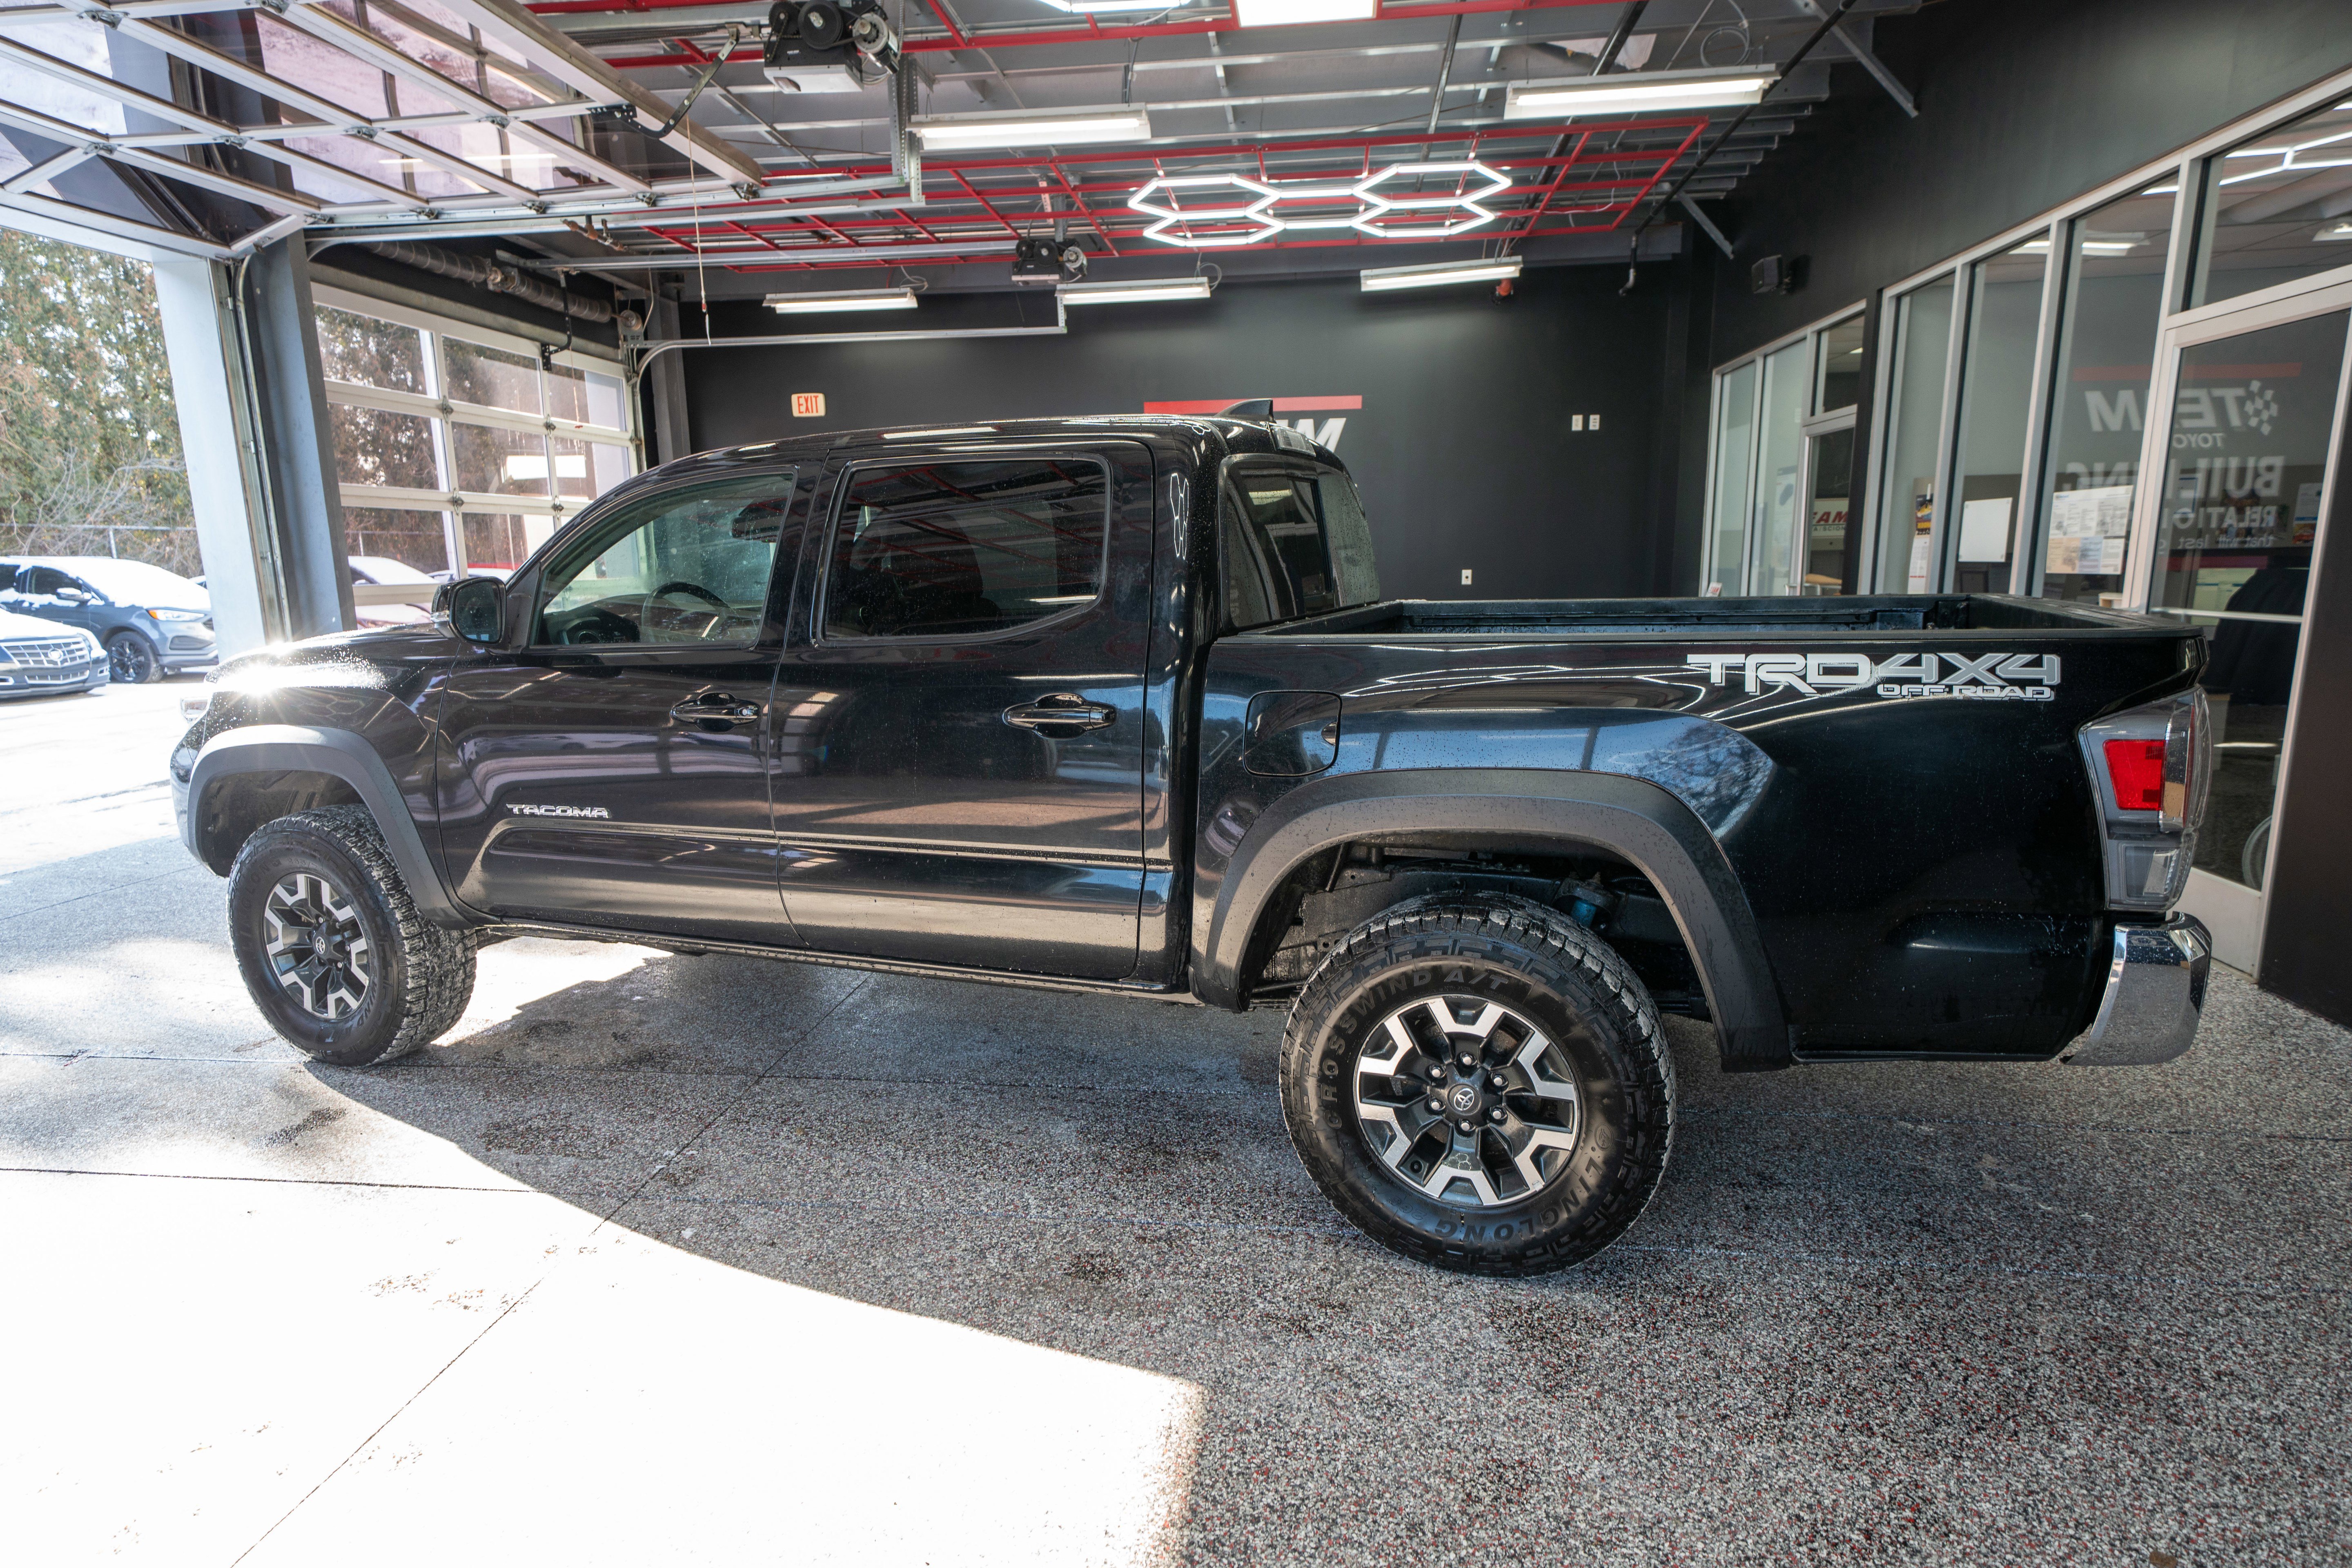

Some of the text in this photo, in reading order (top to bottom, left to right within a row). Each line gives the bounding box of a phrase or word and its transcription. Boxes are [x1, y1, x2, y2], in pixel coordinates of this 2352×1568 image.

[797, 395, 819, 414] EXIT
[1813, 511, 1848, 524] AM
[1687, 653, 1875, 697] TRD
[1878, 684, 2055, 702] OFF ROAD
[506, 804, 612, 818] TACOMA
[1321, 969, 1510, 1129] CROSSWIND A/T
[1434, 1157, 1604, 1242] LINGLONG
